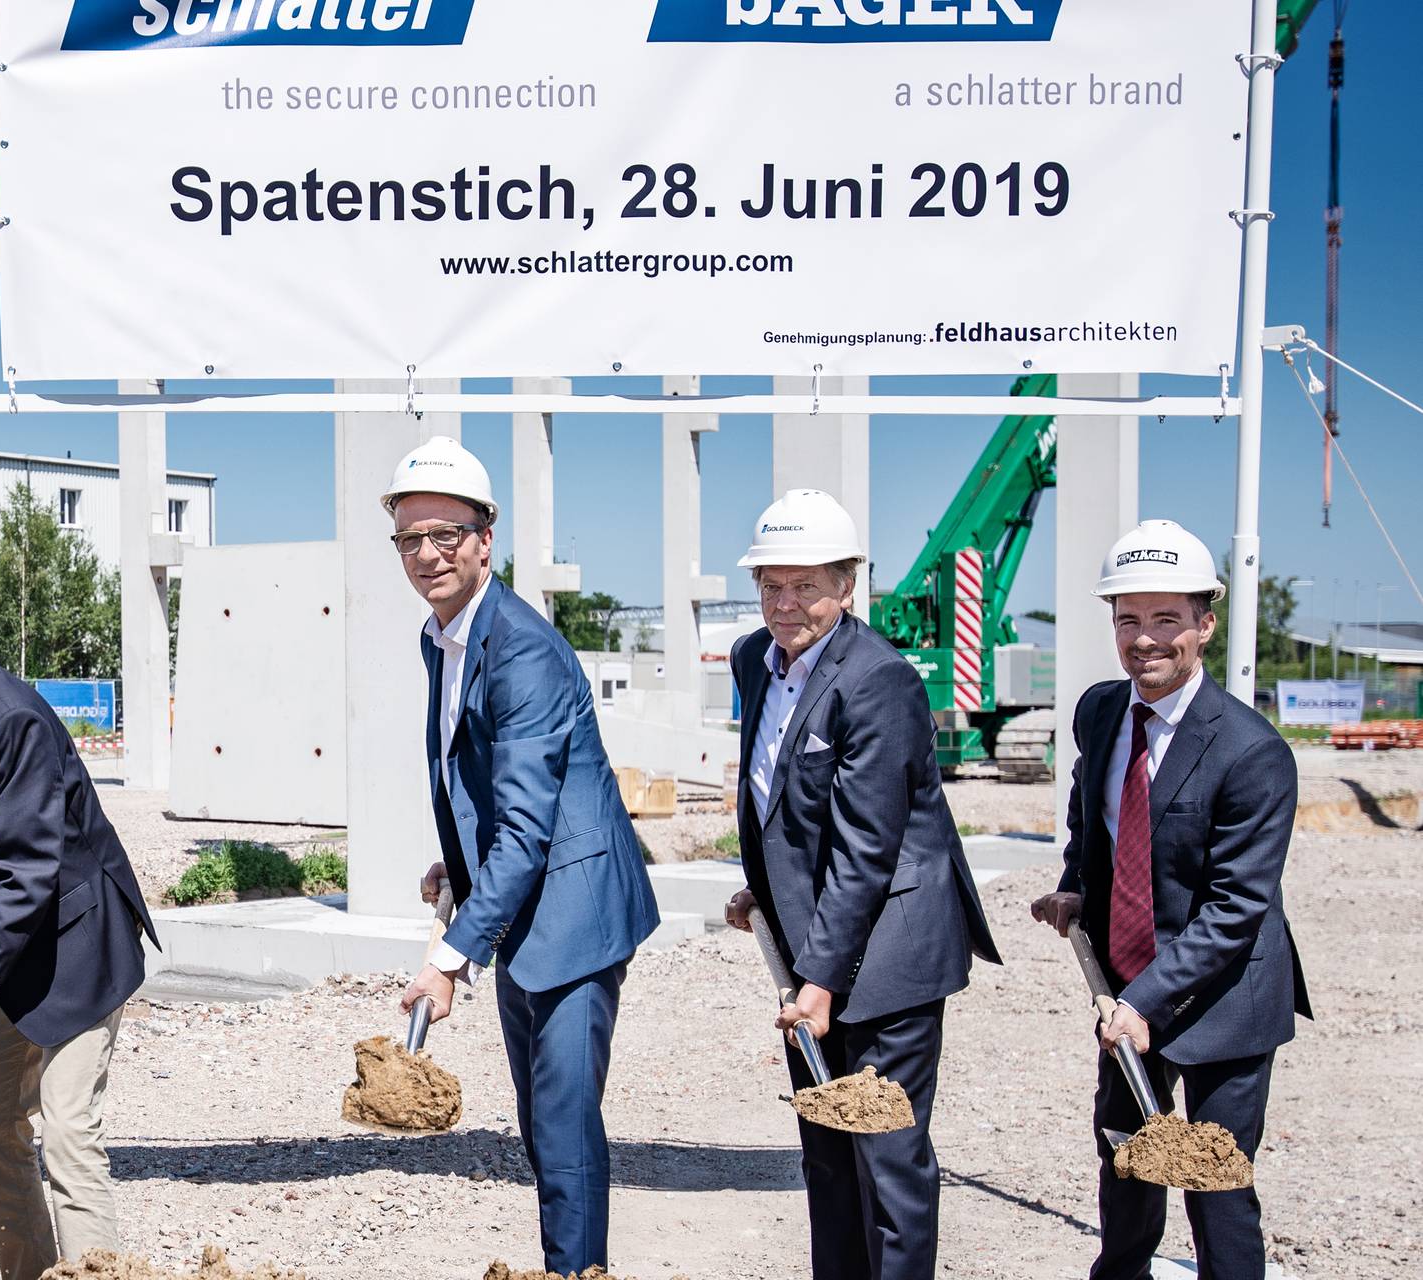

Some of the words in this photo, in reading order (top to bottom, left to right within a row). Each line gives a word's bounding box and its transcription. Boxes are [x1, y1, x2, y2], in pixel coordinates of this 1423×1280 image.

[221, 77, 273, 110] the
[285, 86, 398, 110] secure
[411, 75, 597, 110] connection
[895, 82, 912, 107] a
[926, 72, 1078, 107] schlatter
[1089, 72, 1184, 107] brand
[170, 164, 595, 236] Spatenstich,
[620, 162, 716, 219] 28.
[740, 163, 884, 220] Juni
[908, 161, 1071, 218] 2019
[439, 250, 794, 278] www.schlattergroup.com
[763, 331, 927, 346] Genehmigungsplanung:
